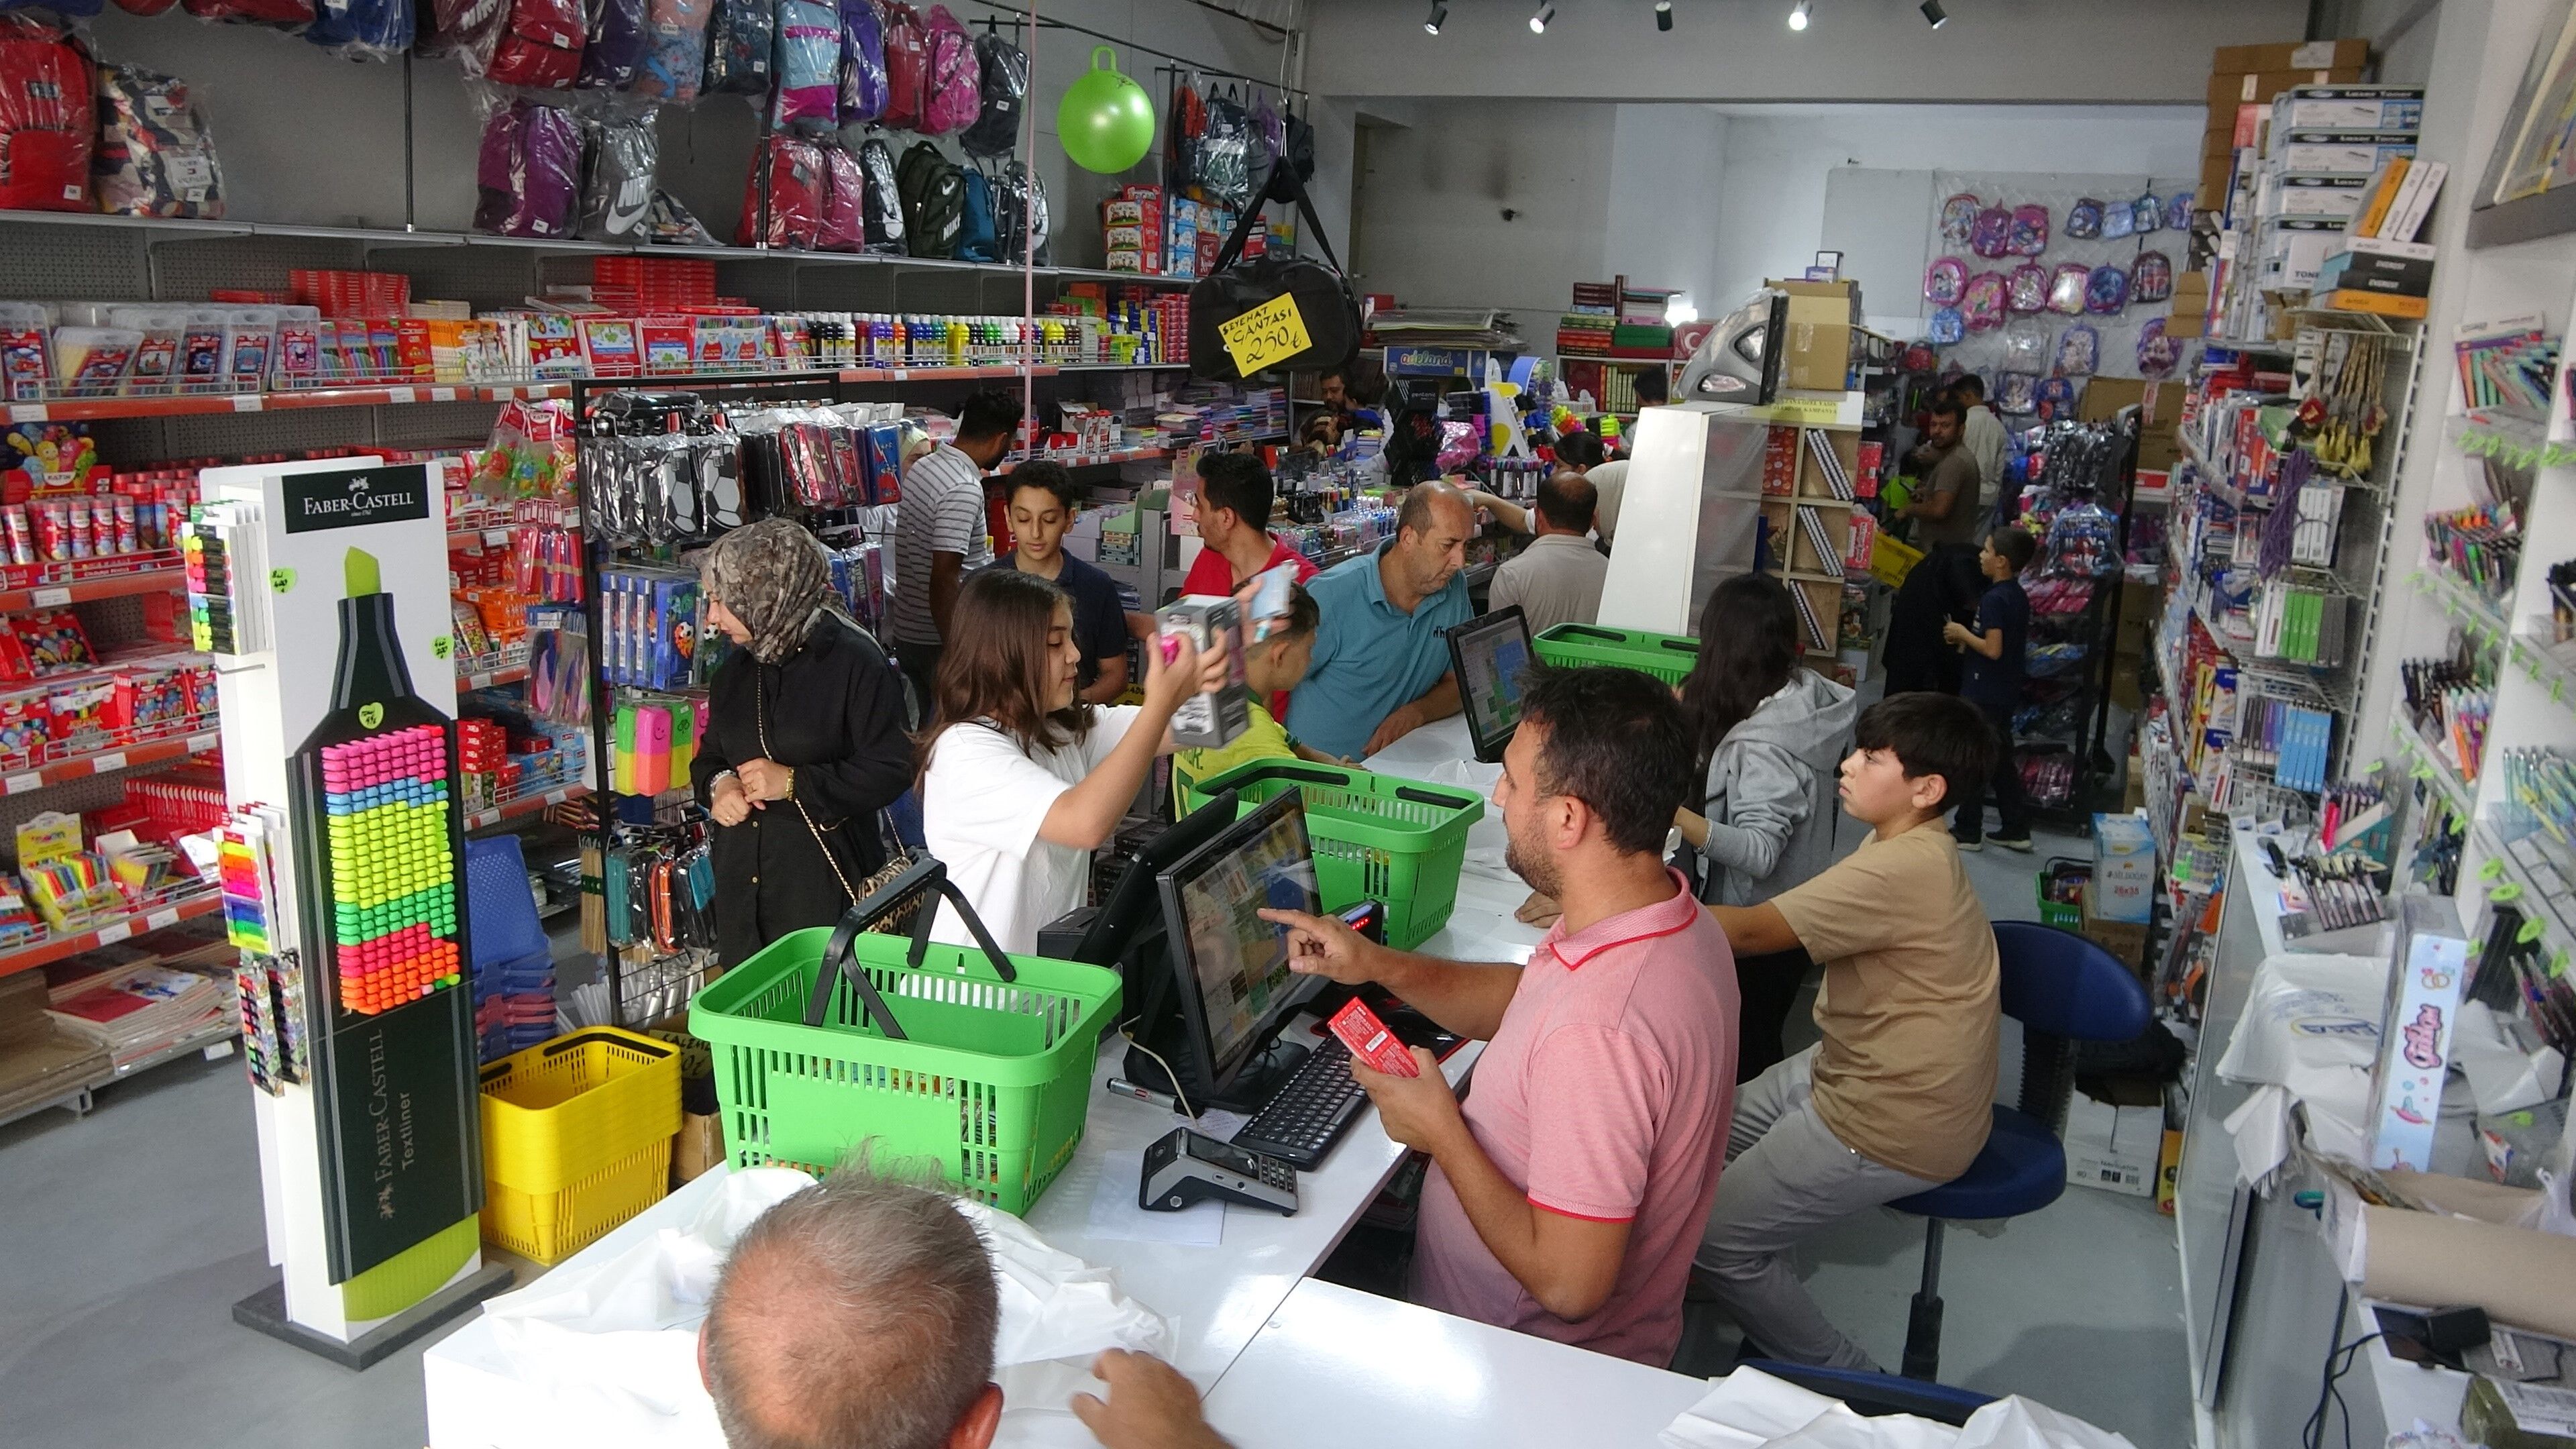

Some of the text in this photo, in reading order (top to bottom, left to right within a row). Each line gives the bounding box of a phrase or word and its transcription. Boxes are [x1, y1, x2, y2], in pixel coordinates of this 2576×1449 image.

[1222, 306, 1269, 335] SEYEHAT
[1401, 350, 1454, 367] adeland
[303, 492, 415, 515] FABER-CASTELL
[368, 1029, 394, 1183] FABER-CASTELL
[399, 1091, 415, 1171] Textliner
